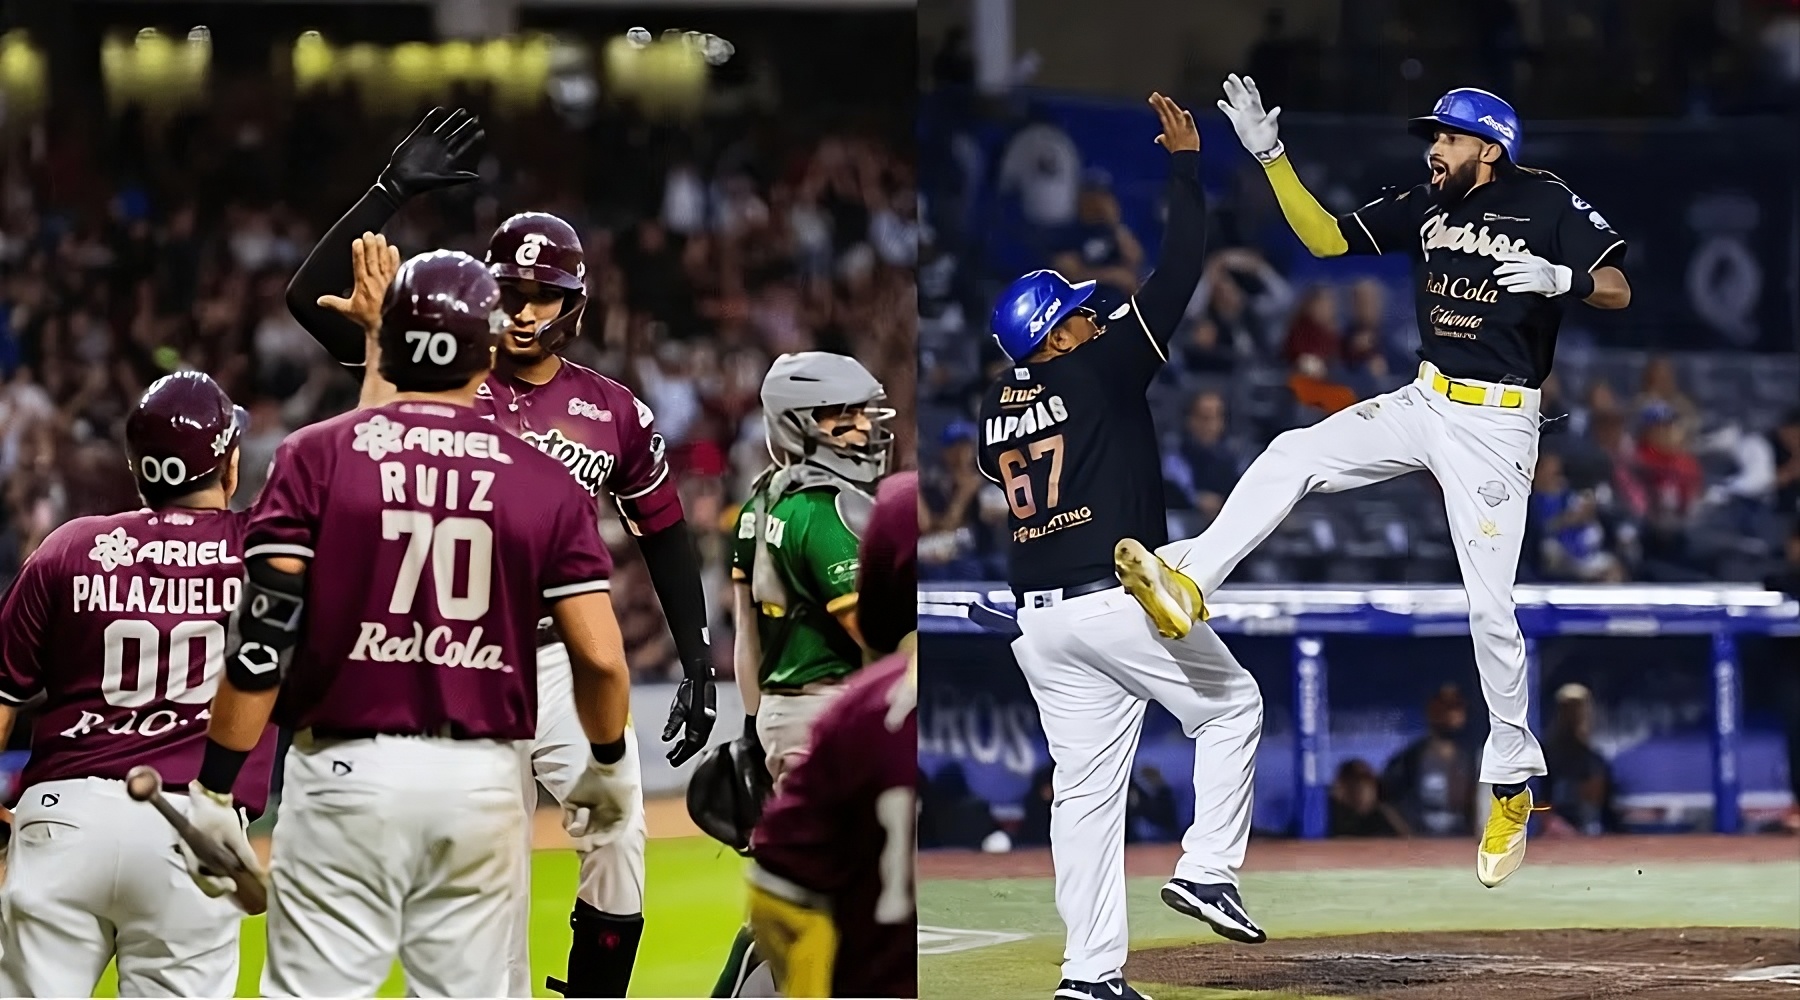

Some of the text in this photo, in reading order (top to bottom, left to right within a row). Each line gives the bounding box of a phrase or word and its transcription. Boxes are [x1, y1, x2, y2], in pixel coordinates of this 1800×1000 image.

[1450, 277, 1499, 304] Cola
[405, 331, 457, 365] 70
[403, 427, 514, 464] ARIEL
[141, 455, 187, 486] 00
[379, 461, 496, 512] RUIZ
[999, 434, 1064, 520] 67
[136, 539, 243, 567] ARIEL
[381, 508, 493, 622] 70
[101, 619, 226, 708] 00
